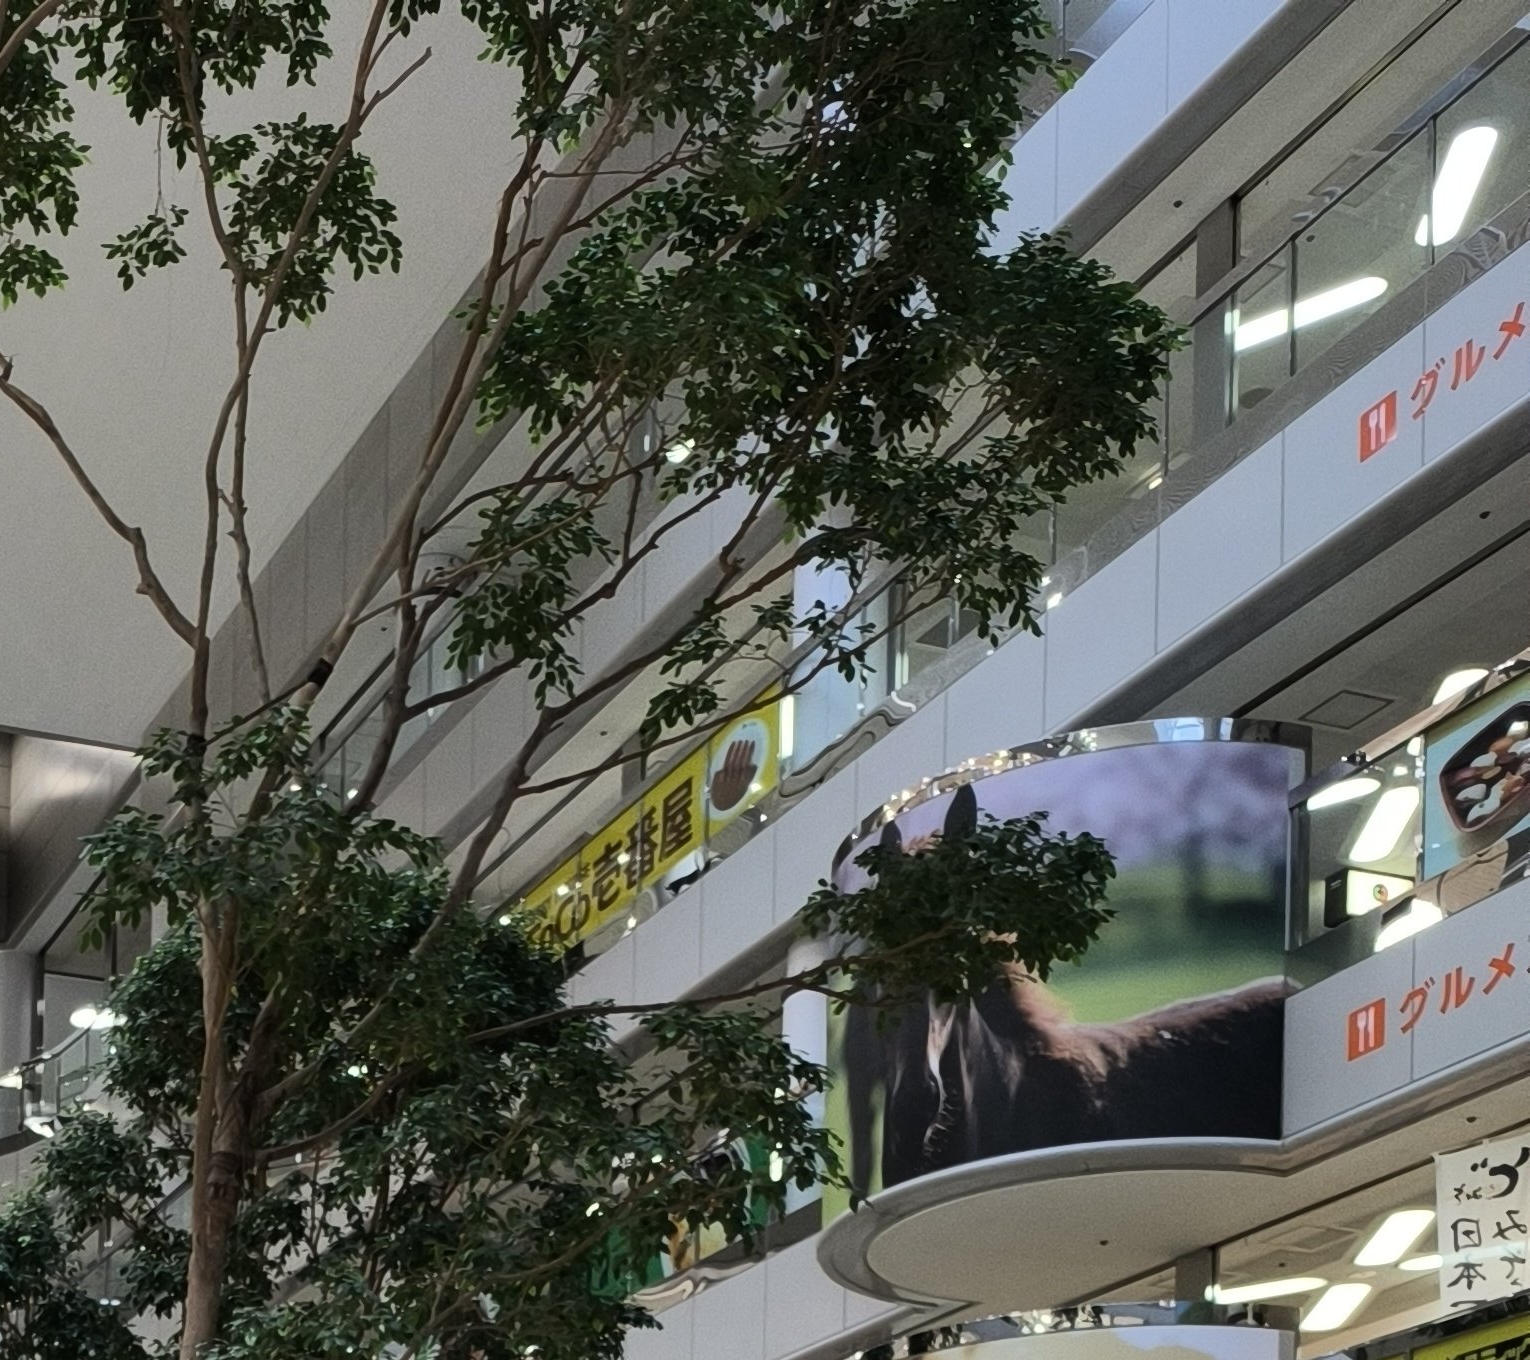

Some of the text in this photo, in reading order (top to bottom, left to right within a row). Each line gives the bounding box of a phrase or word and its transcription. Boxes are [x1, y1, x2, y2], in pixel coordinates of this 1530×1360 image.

[1410, 301, 1527, 421] グルメ
[1399, 942, 1530, 1034] グルメ
